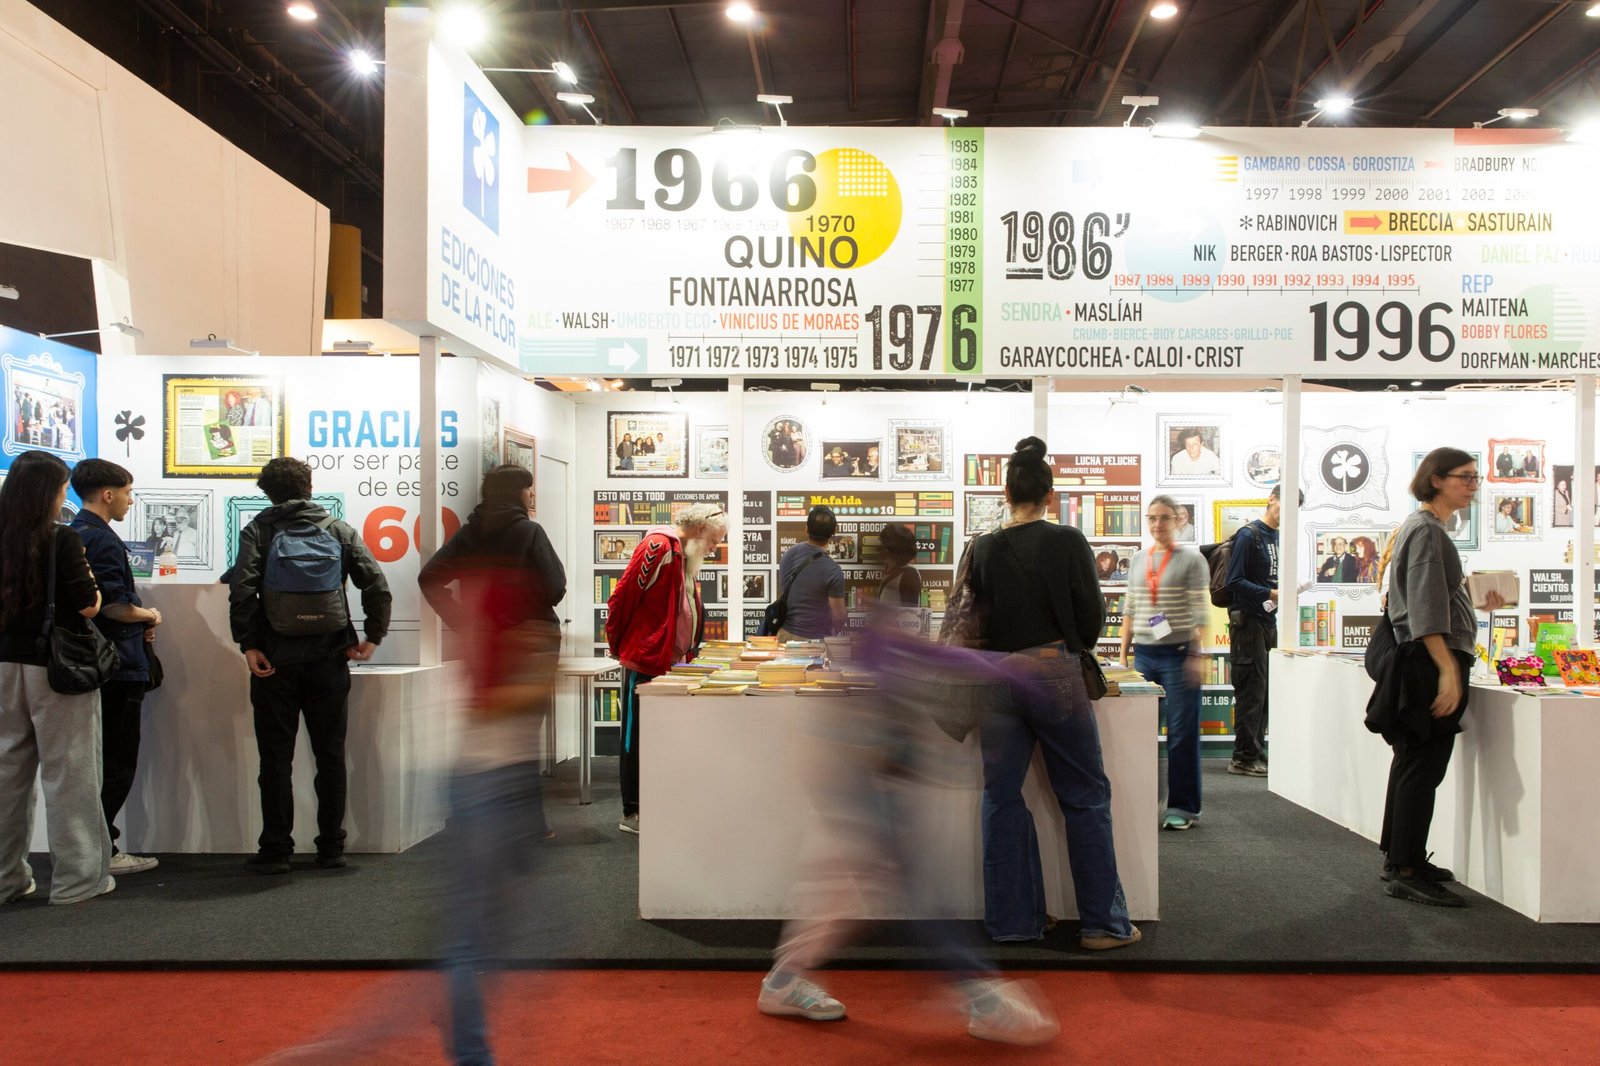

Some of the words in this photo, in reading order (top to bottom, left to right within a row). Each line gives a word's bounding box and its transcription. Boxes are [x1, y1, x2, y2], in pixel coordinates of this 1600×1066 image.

[950, 140, 978, 153] 1985
[950, 158, 978, 171] 1984
[1244, 157, 1300, 172] GAMBARO
[1308, 157, 1346, 172] COSSA
[1352, 157, 1415, 172] GOROSTIZA
[1454, 158, 1514, 172] BRADBURY
[605, 147, 817, 212] 1966
[950, 176, 978, 188] 1983
[950, 193, 976, 206] 1982
[1246, 188, 1278, 200] 1997
[1289, 188, 1321, 200] 1998
[1332, 188, 1365, 200] 1999
[1375, 188, 1408, 200] 2000
[1418, 188, 1451, 200] 2001
[1462, 188, 1494, 200] 2002
[605, 219, 634, 230] 1967
[642, 219, 670, 230] 1968
[806, 215, 855, 232] 1970
[950, 211, 974, 224] 1981
[1256, 214, 1337, 232] RABINOVICH
[1389, 212, 1453, 232] BRECCIA
[1468, 212, 1552, 232] SASTURAIN
[950, 228, 978, 241] 1980
[724, 235, 858, 269] QUINO
[950, 245, 976, 258] 1979
[1193, 244, 1216, 262] NIK
[1230, 245, 1282, 262] BERGER
[1291, 245, 1317, 262] ROA
[1322, 245, 1373, 262] BASTOS
[1382, 245, 1452, 262] LISPECTOR
[1482, 245, 1530, 264] DANIEL
[1536, 245, 1560, 264] PAZ
[442, 226, 514, 310] EDICIONES
[950, 262, 976, 275] 1978
[950, 280, 975, 292] 1977
[1114, 274, 1140, 286] 1987
[1146, 274, 1174, 286] 1988
[1182, 274, 1210, 286] 1989
[1217, 274, 1245, 286] 1990
[1252, 274, 1277, 286] 1991
[1284, 274, 1311, 286] 1992
[1316, 274, 1344, 286] 1993
[1352, 274, 1379, 286] 1994
[1388, 274, 1415, 286] 1995
[1462, 274, 1492, 293] REP
[670, 276, 858, 306] FONTANARROSA
[442, 272, 460, 315] DE
[465, 287, 481, 328] LA
[486, 302, 515, 349] FLOR
[1001, 302, 1062, 322] SENDRA
[1075, 298, 1142, 322] MASLÍAH
[1462, 298, 1528, 317] MAITENA
[562, 312, 608, 329] WALSH
[617, 312, 680, 330] UMBERTO
[685, 312, 710, 330] ECO
[720, 313, 778, 330] VINICIUS
[783, 314, 799, 330] DE
[804, 313, 859, 330] MORAES
[864, 304, 978, 372] 1976
[1073, 328, 1108, 340] CRUMB
[1113, 328, 1148, 340] BIERCE
[1153, 328, 1176, 340] BIOY
[1178, 328, 1228, 340] CARSARES
[1234, 328, 1270, 340] GRILLO
[1274, 328, 1292, 340] POE
[1310, 301, 1456, 362] 1996
[1461, 324, 1500, 339] BOBBY
[1504, 324, 1547, 339] FLORES
[669, 345, 700, 368] 1971
[706, 345, 740, 368] 1972
[745, 345, 778, 368] 1973
[784, 345, 818, 368] 1974
[823, 345, 858, 368] 1975
[1000, 346, 1121, 368] GARAYCOCHEA
[1134, 346, 1183, 368] CALOI
[1194, 346, 1244, 368] CRIST
[1461, 352, 1528, 369] DORFMAN
[354, 454, 389, 470] ser
[1076, 456, 1100, 466] LUCHA
[1104, 456, 1138, 466] PELUCHE
[358, 477, 387, 496] de
[397, 480, 458, 496] ess
[598, 492, 617, 500] ESTO
[620, 492, 630, 500] NO
[633, 492, 642, 500] ES
[645, 492, 665, 500] TODO
[810, 496, 862, 505] Mafalda
[880, 506, 894, 514] 10
[838, 523, 858, 532] TODO
[744, 532, 762, 542] EYRA
[915, 540, 934, 550] tro
[744, 554, 769, 563] MERCI
[854, 570, 864, 580] DE
[1532, 573, 1564, 583] WALSH,
[1532, 584, 1569, 592] CUENTOS
[1495, 618, 1516, 627] ONES
[1344, 626, 1371, 636] DANTE
[1202, 696, 1212, 706] DE
[1214, 696, 1229, 706] LOS
